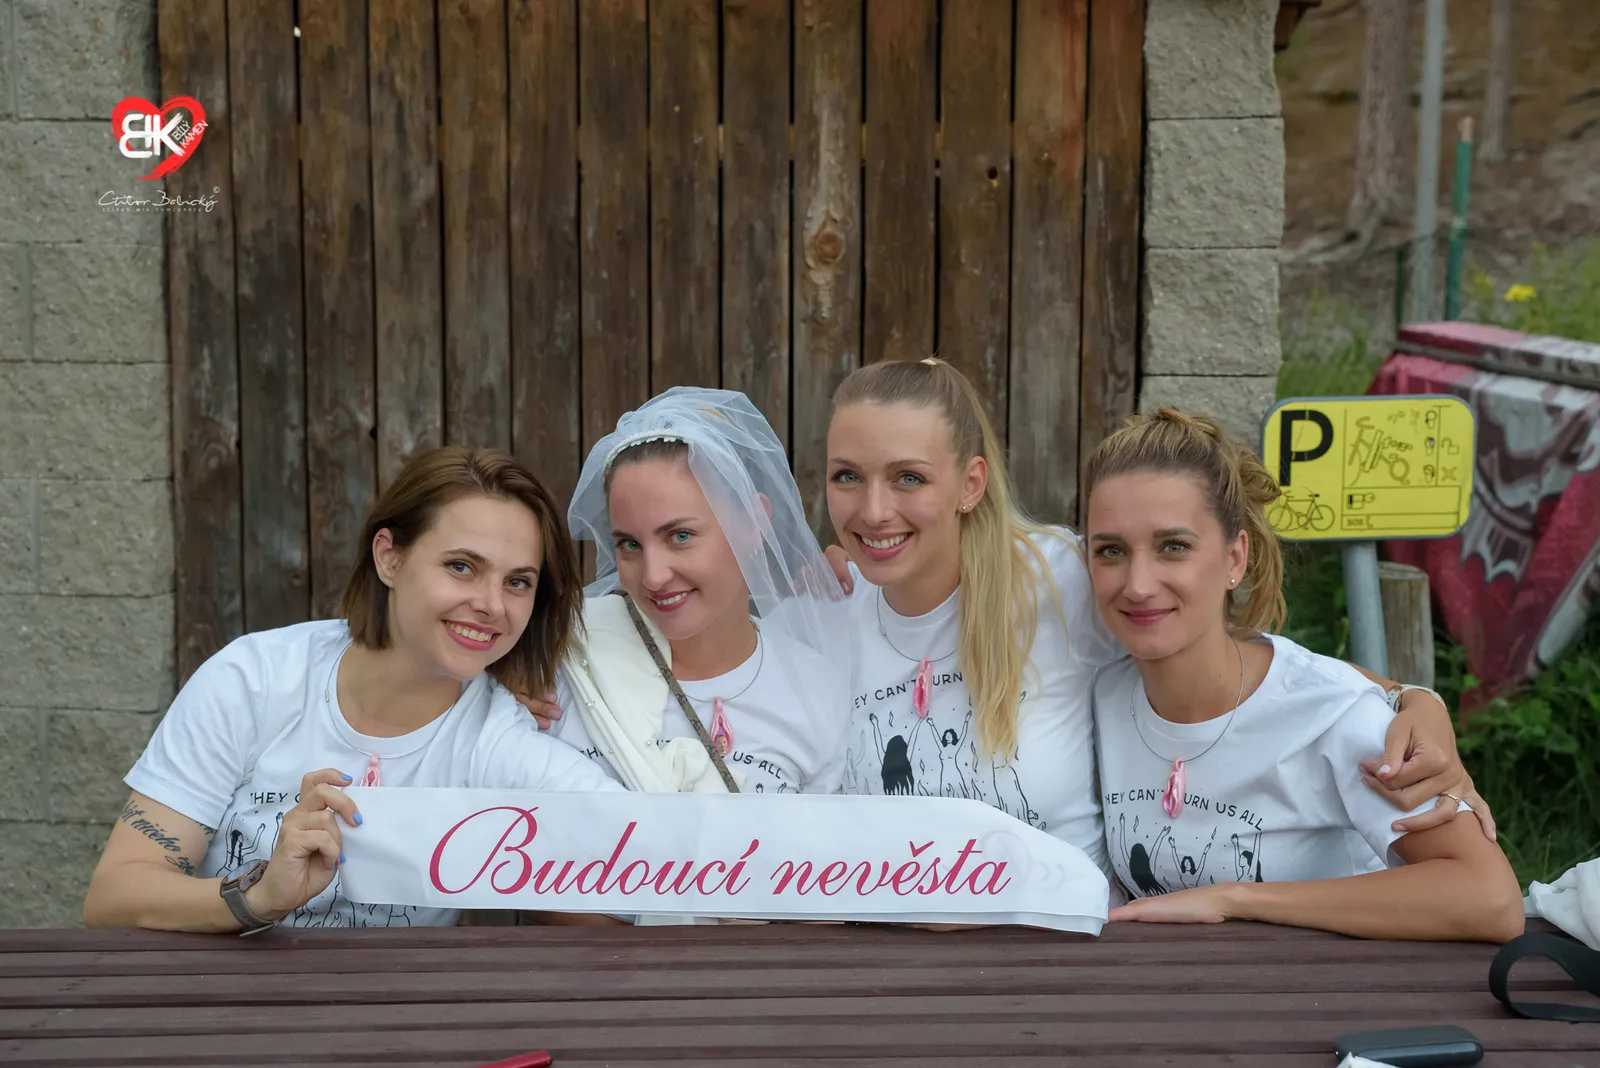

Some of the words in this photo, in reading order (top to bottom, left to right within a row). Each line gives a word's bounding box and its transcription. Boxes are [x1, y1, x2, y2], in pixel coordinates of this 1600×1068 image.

[1279, 409, 1334, 487] P
[932, 671, 963, 687] URN
[732, 750, 754, 765] US
[758, 759, 781, 780] ALL
[1105, 792, 1125, 805] HEY
[1128, 788, 1165, 802] CAN'
[1183, 792, 1210, 811] URN
[1215, 801, 1237, 818] US
[1239, 809, 1263, 832] ALL
[429, 806, 758, 895] Budoucí
[770, 839, 1012, 895] nevěsta
